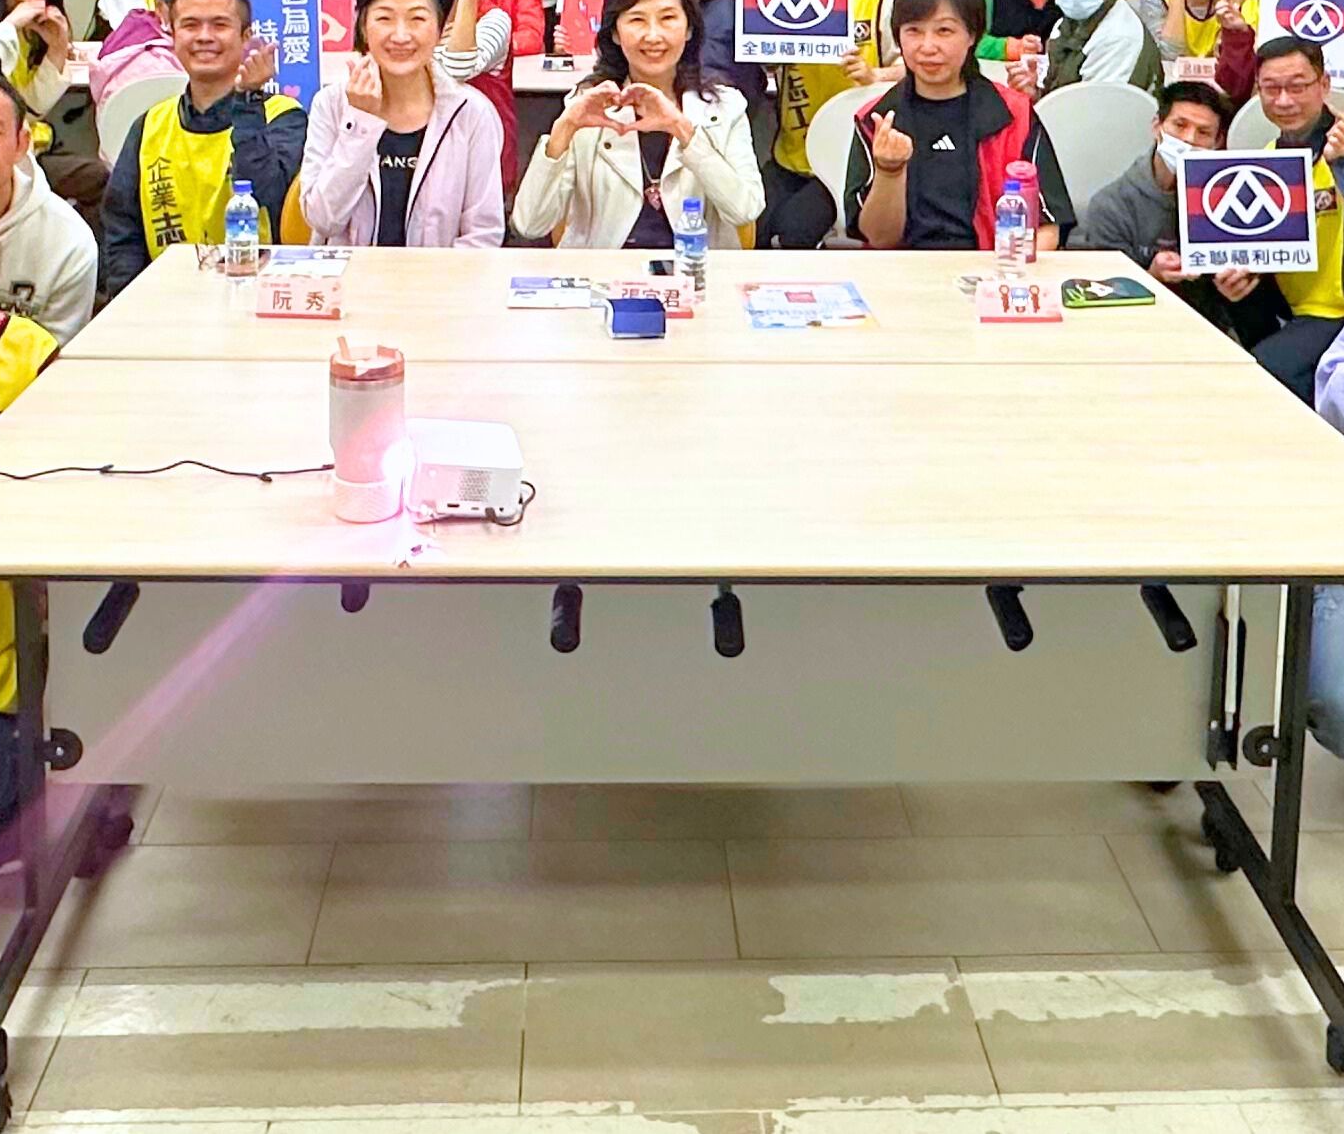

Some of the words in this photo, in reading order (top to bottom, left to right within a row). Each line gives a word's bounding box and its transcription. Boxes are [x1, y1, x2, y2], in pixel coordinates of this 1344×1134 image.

[742, 41, 849, 56] 全聯福利中心
[1189, 249, 1312, 267] 全聯福利中心
